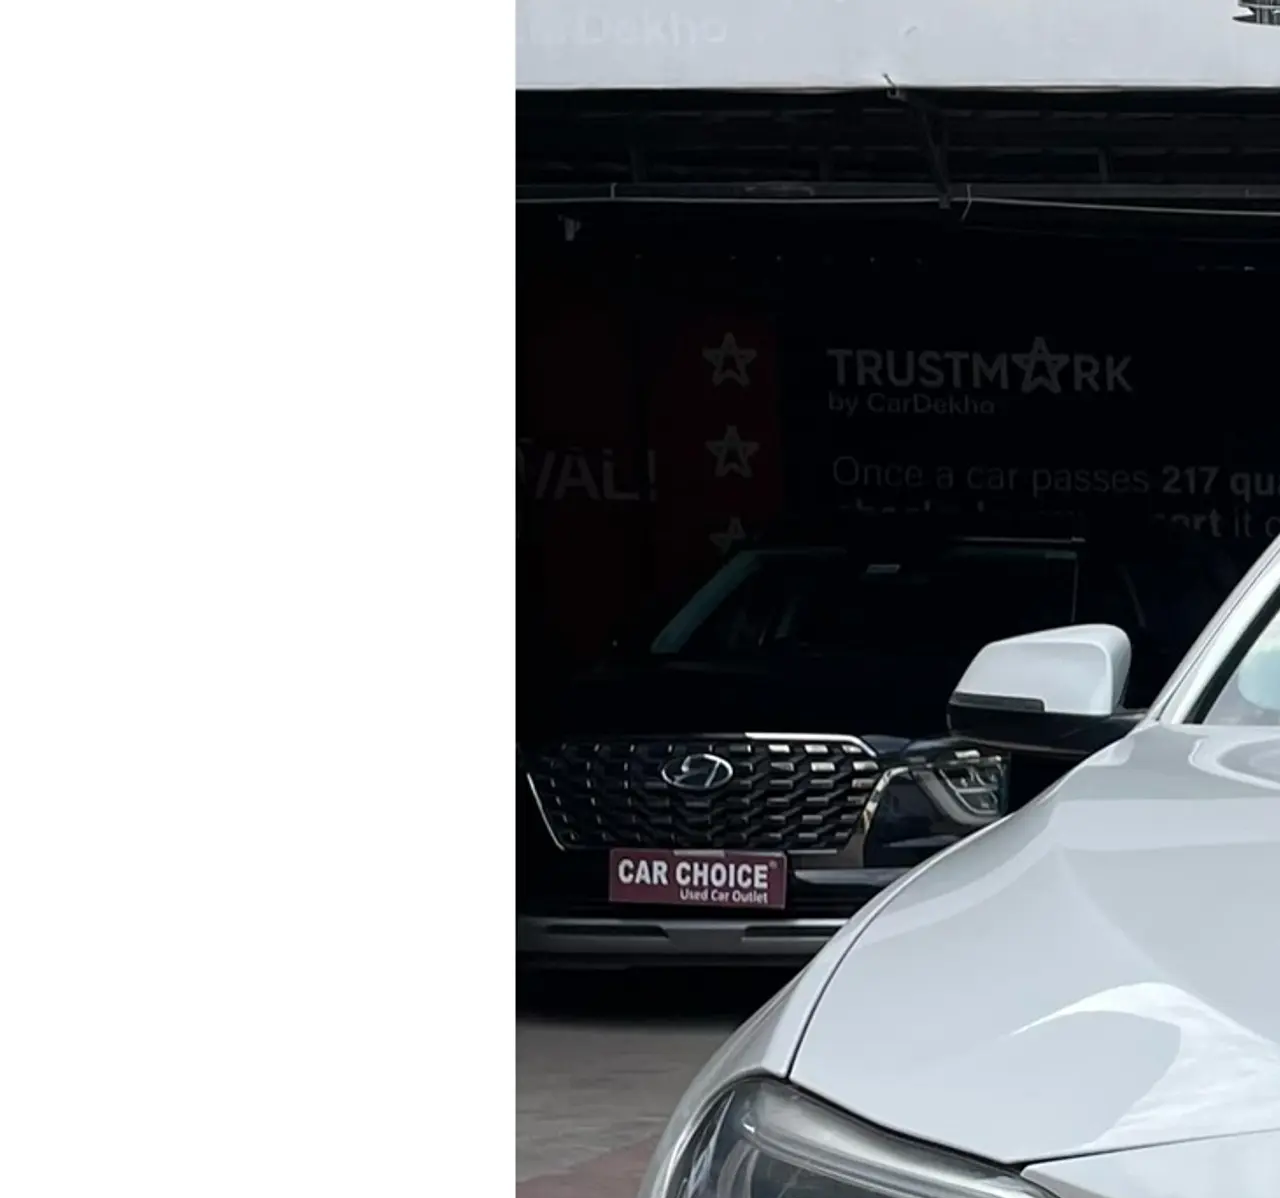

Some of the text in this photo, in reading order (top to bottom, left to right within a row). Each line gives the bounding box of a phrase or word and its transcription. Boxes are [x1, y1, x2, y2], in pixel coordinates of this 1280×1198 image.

[828, 391, 996, 418] by CarDekho
[832, 455, 923, 487] Once
[936, 465, 955, 490] a
[966, 465, 1019, 490] car
[1032, 468, 1150, 500] passes
[1161, 465, 1221, 495] 217
[618, 859, 669, 885] CAR
[680, 888, 768, 904] Used Car Outlet
